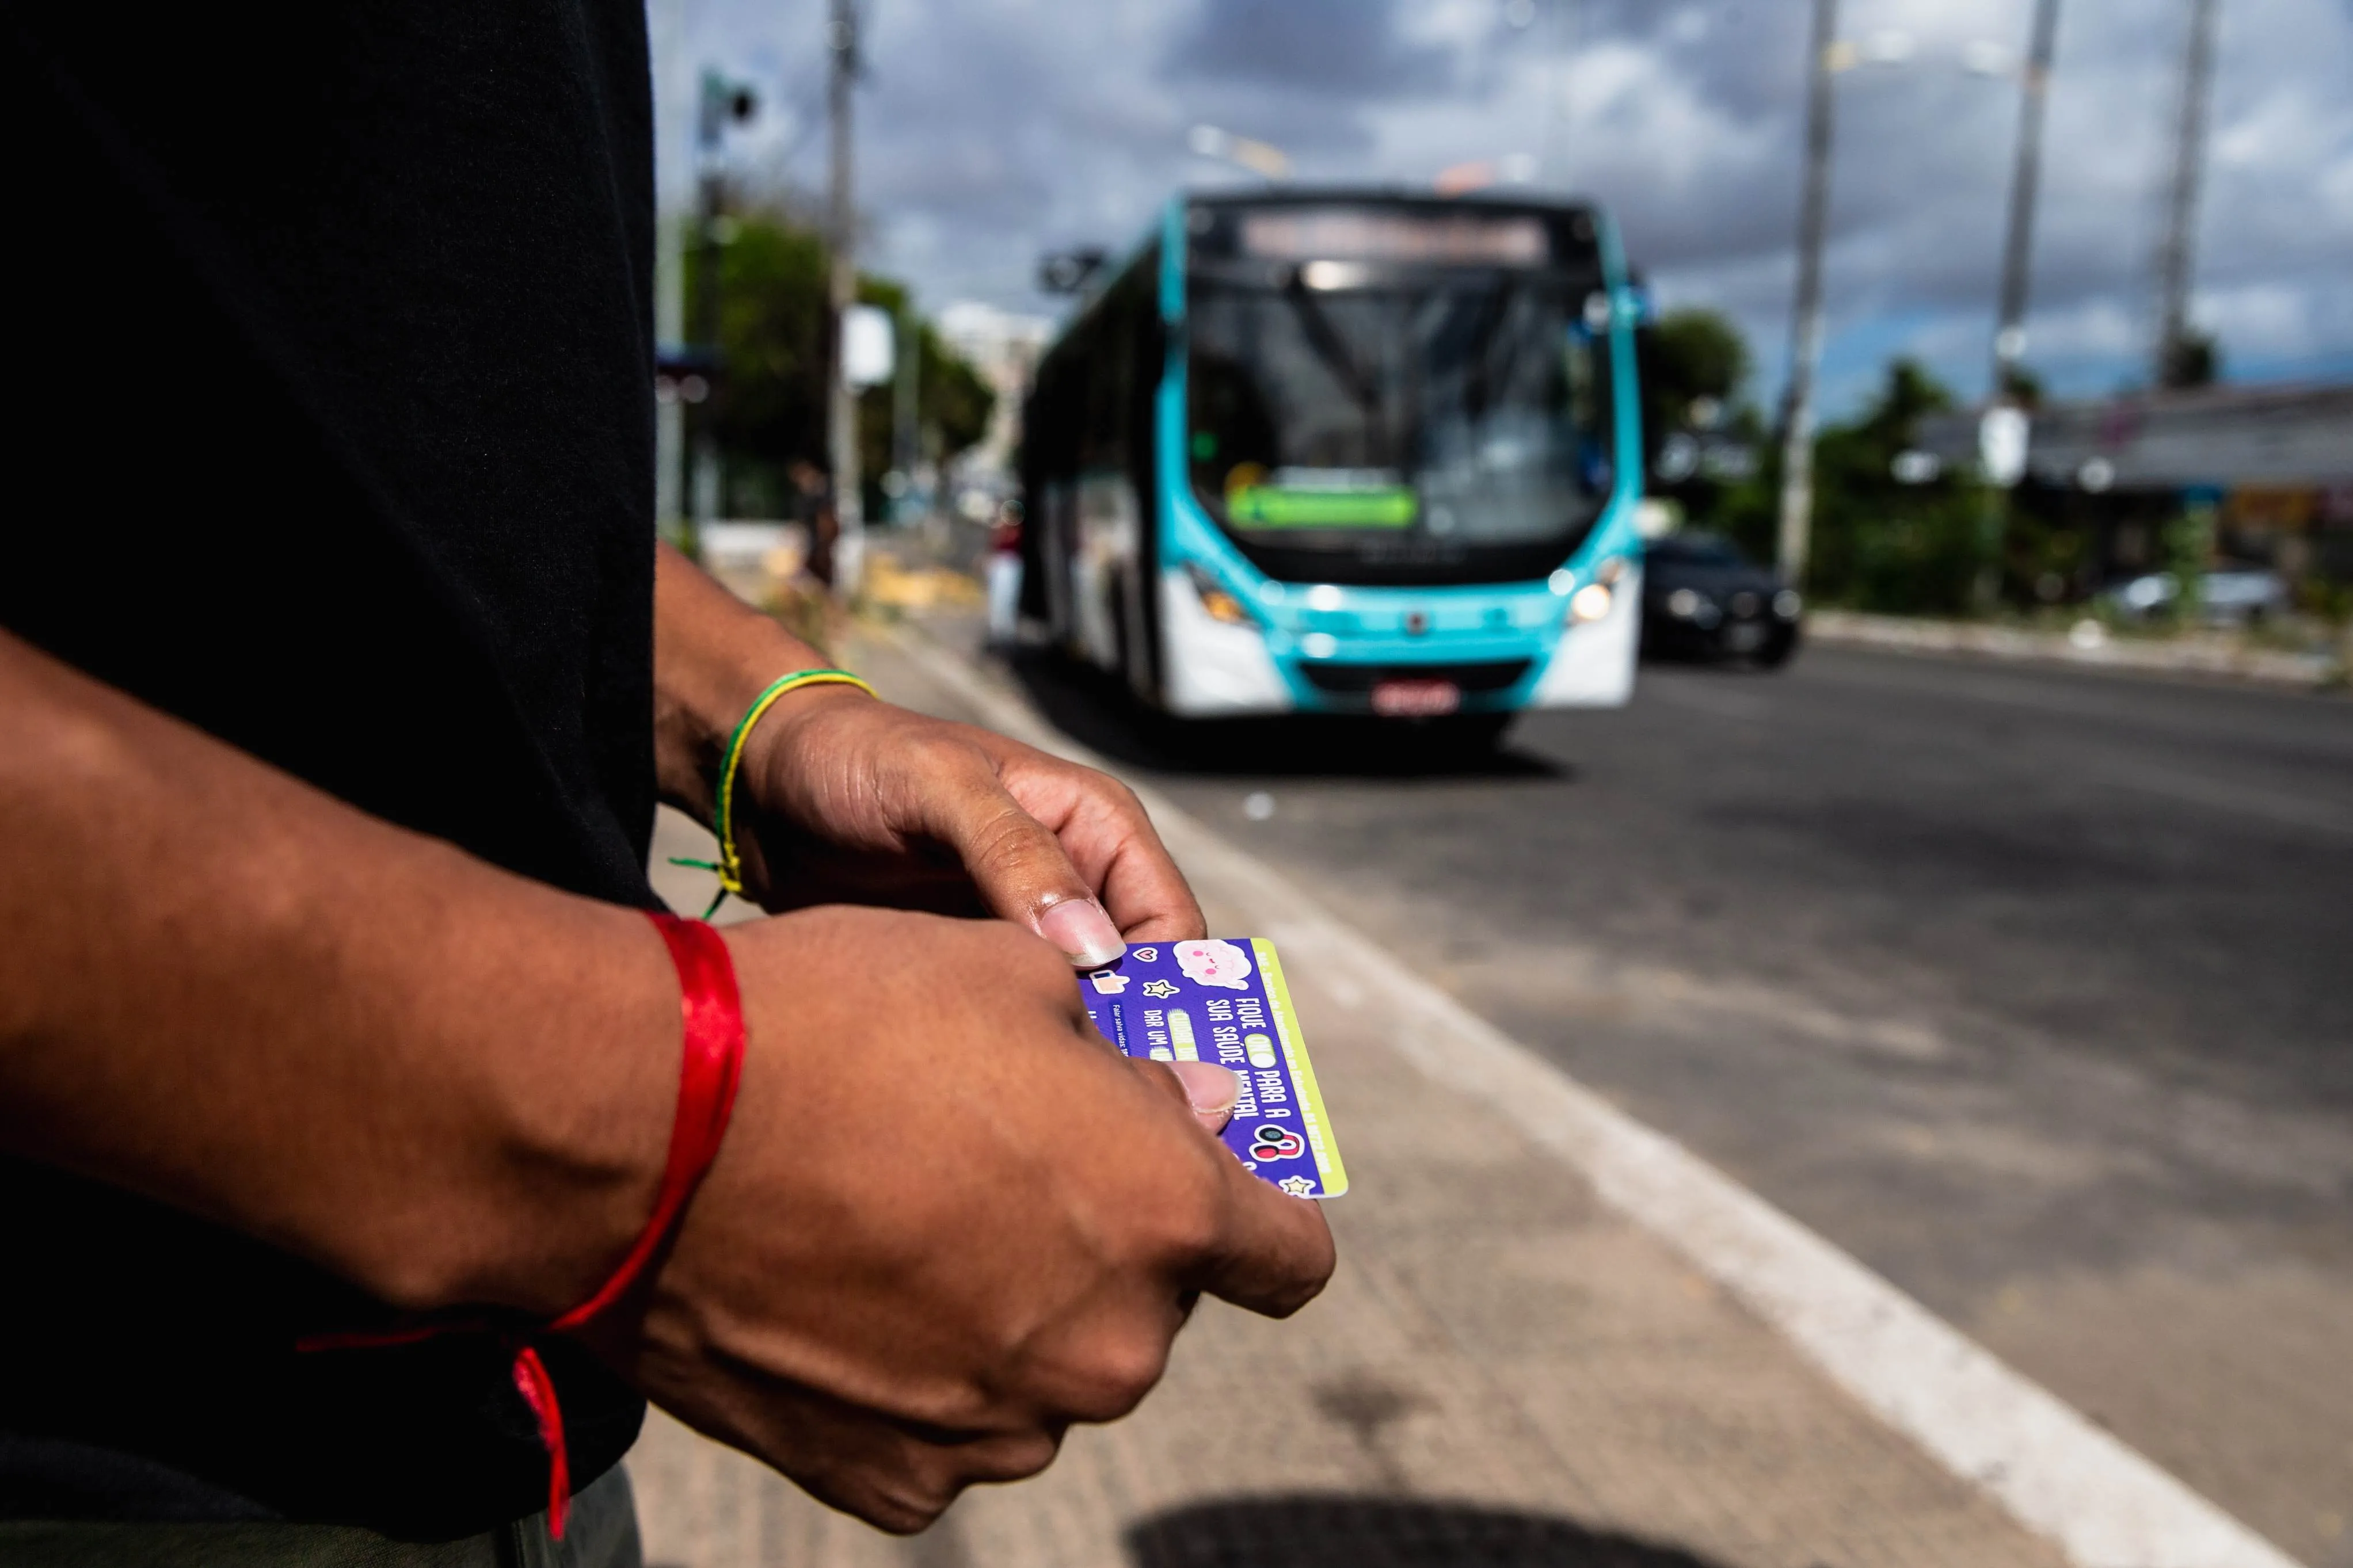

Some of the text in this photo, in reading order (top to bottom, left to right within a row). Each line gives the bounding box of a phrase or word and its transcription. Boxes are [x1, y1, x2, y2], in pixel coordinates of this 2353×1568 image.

[1206, 999, 1233, 1021] SUA
[1270, 1000, 1280, 1009] de
[1144, 1010, 1164, 1028] DAR
[1170, 1013, 1194, 1043] CUIDAR
[1118, 1033, 1126, 1047] vidas:
[1147, 1031, 1168, 1046] UM
[1213, 1026, 1246, 1065] SAÚDE
[1235, 998, 1291, 1119] FIQUE ON PARA A
